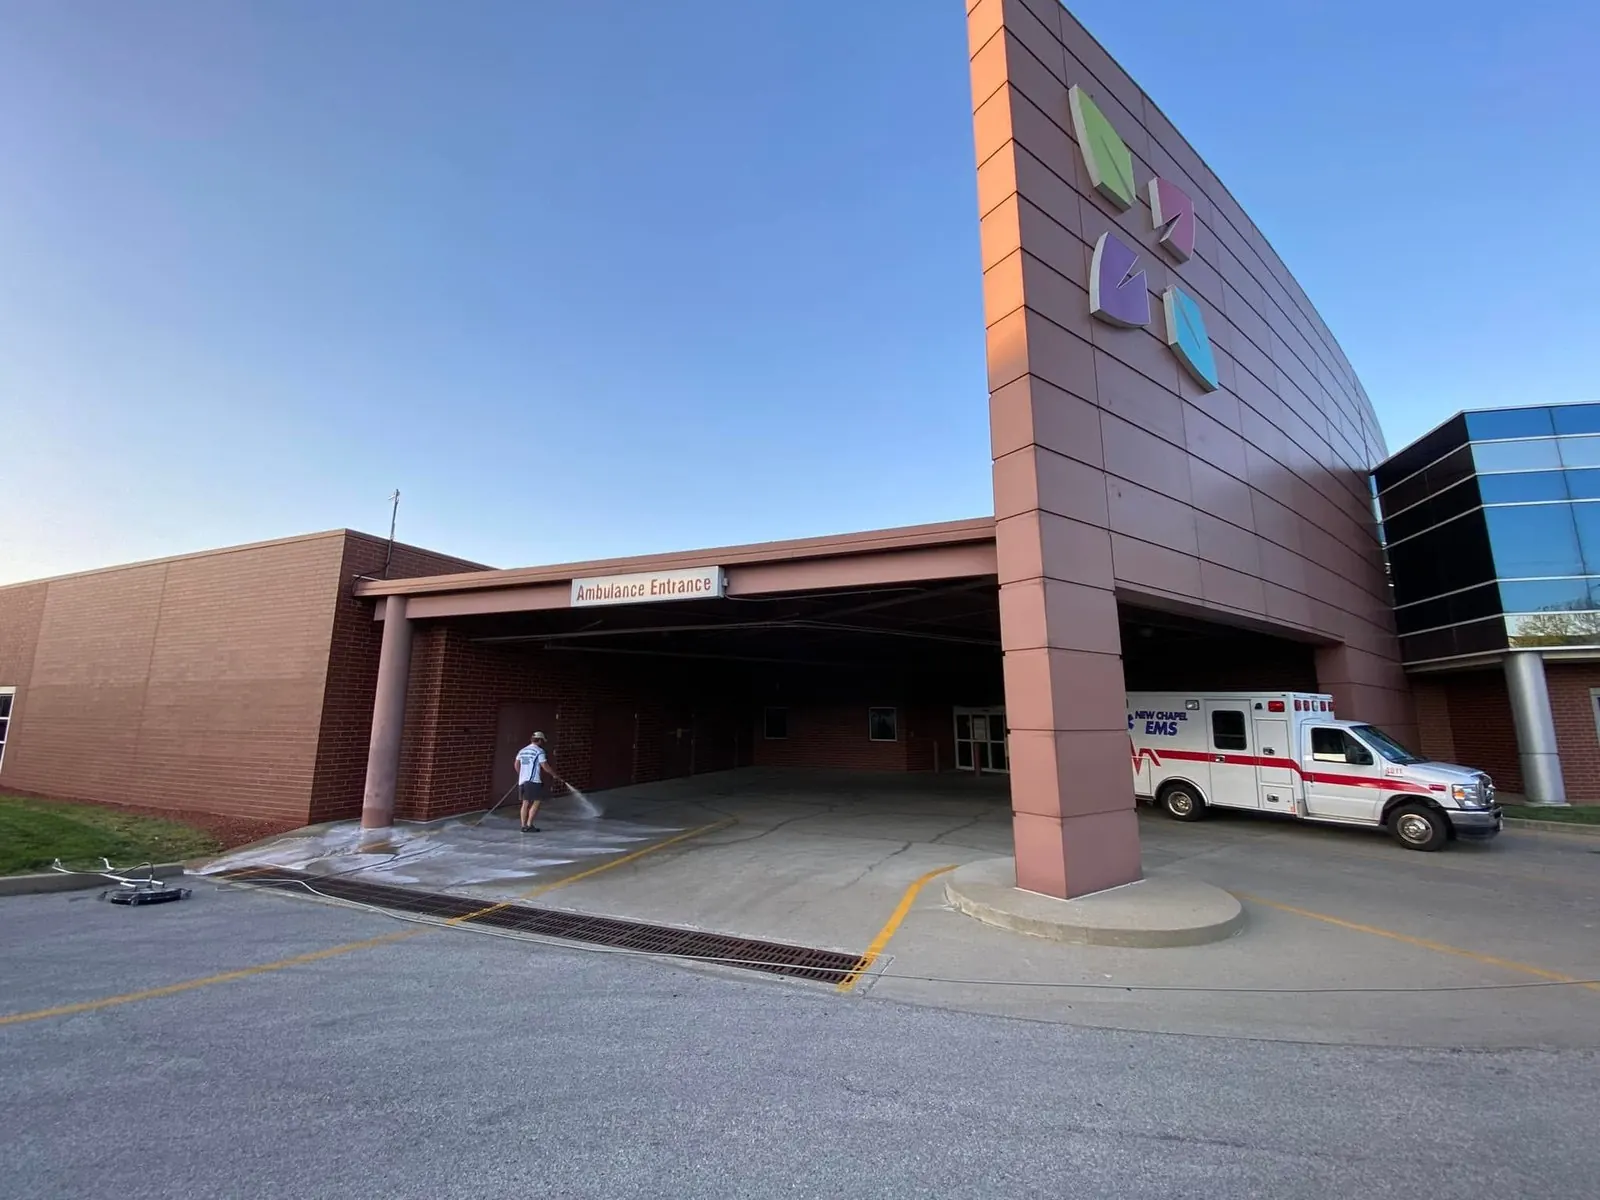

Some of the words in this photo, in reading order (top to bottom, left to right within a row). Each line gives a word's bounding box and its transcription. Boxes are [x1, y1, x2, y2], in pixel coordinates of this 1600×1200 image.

[576, 582, 645, 601] Ambulance
[650, 577, 712, 596] Entrance
[1134, 710, 1155, 720] NEW
[1155, 711, 1188, 721] CHAPEL
[1145, 721, 1178, 736] EMS
